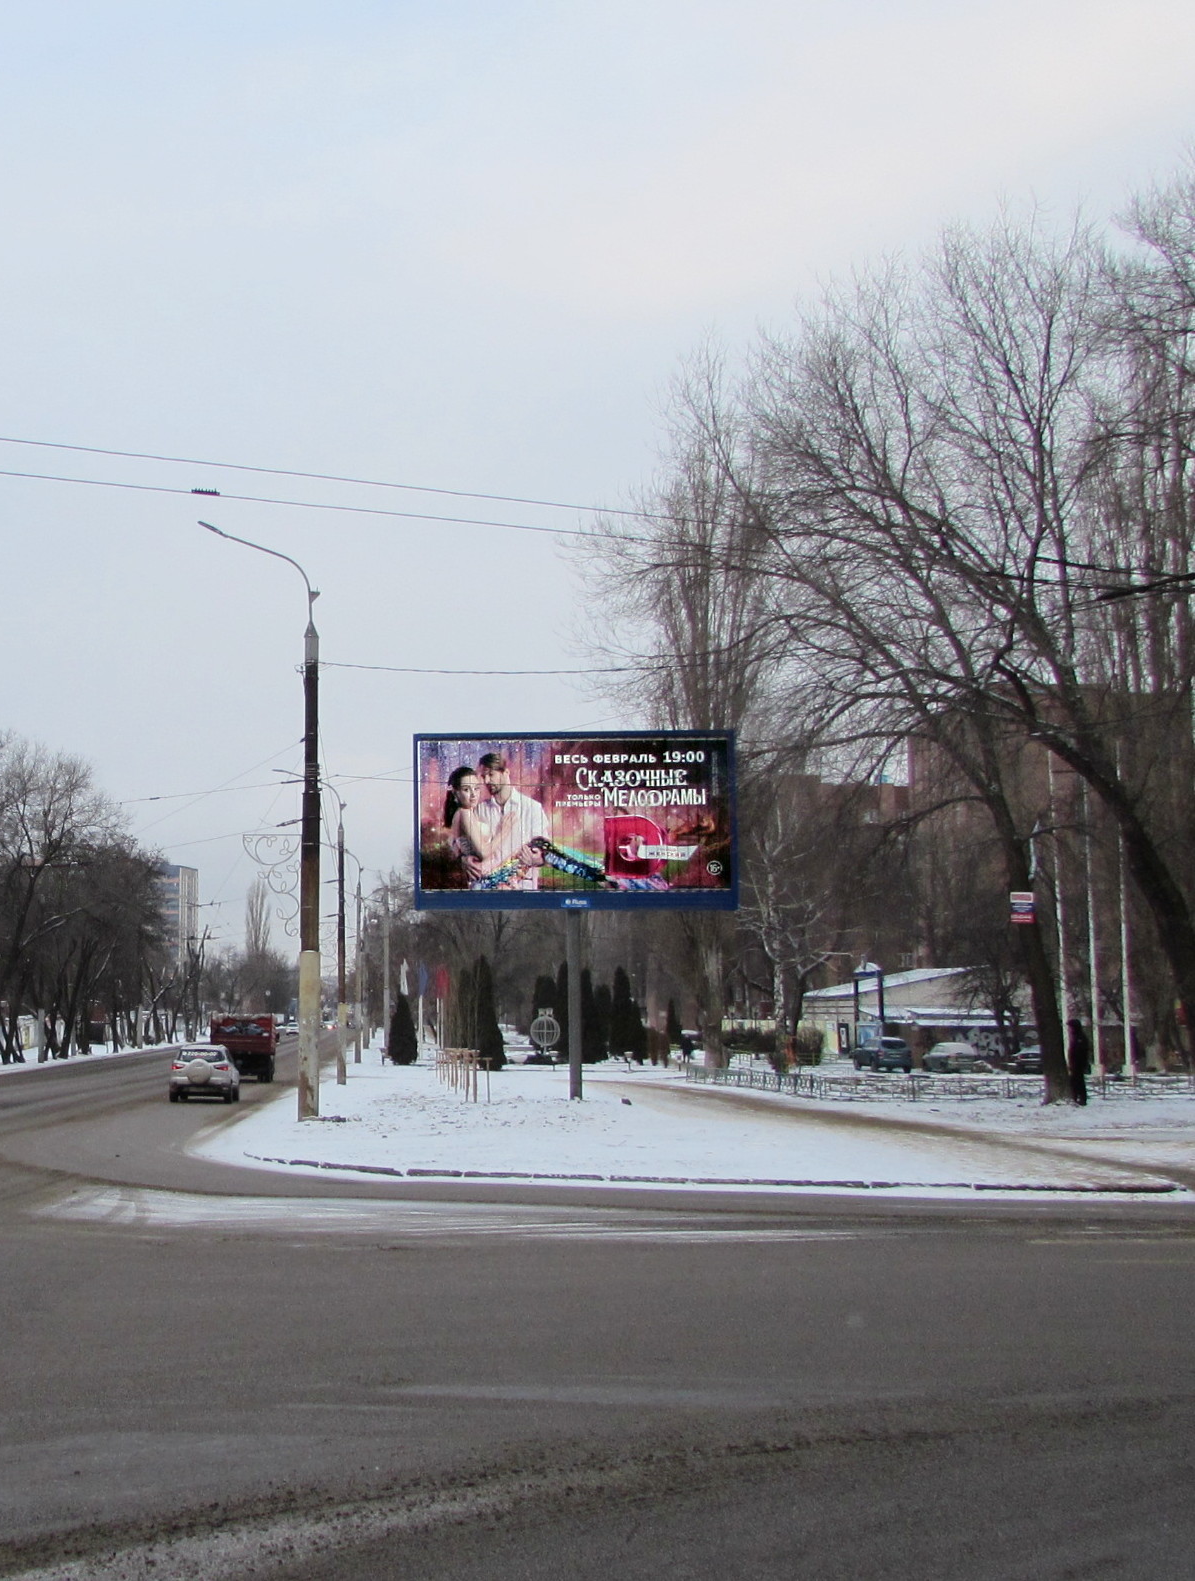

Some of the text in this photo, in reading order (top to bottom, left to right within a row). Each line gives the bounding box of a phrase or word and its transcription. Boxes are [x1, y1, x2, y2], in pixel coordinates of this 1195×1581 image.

[555, 751, 705, 764] ВЕСЬ ФЕВРАЛЬ 19:00
[576, 767, 688, 791] СКАЗОЧНЫЕ
